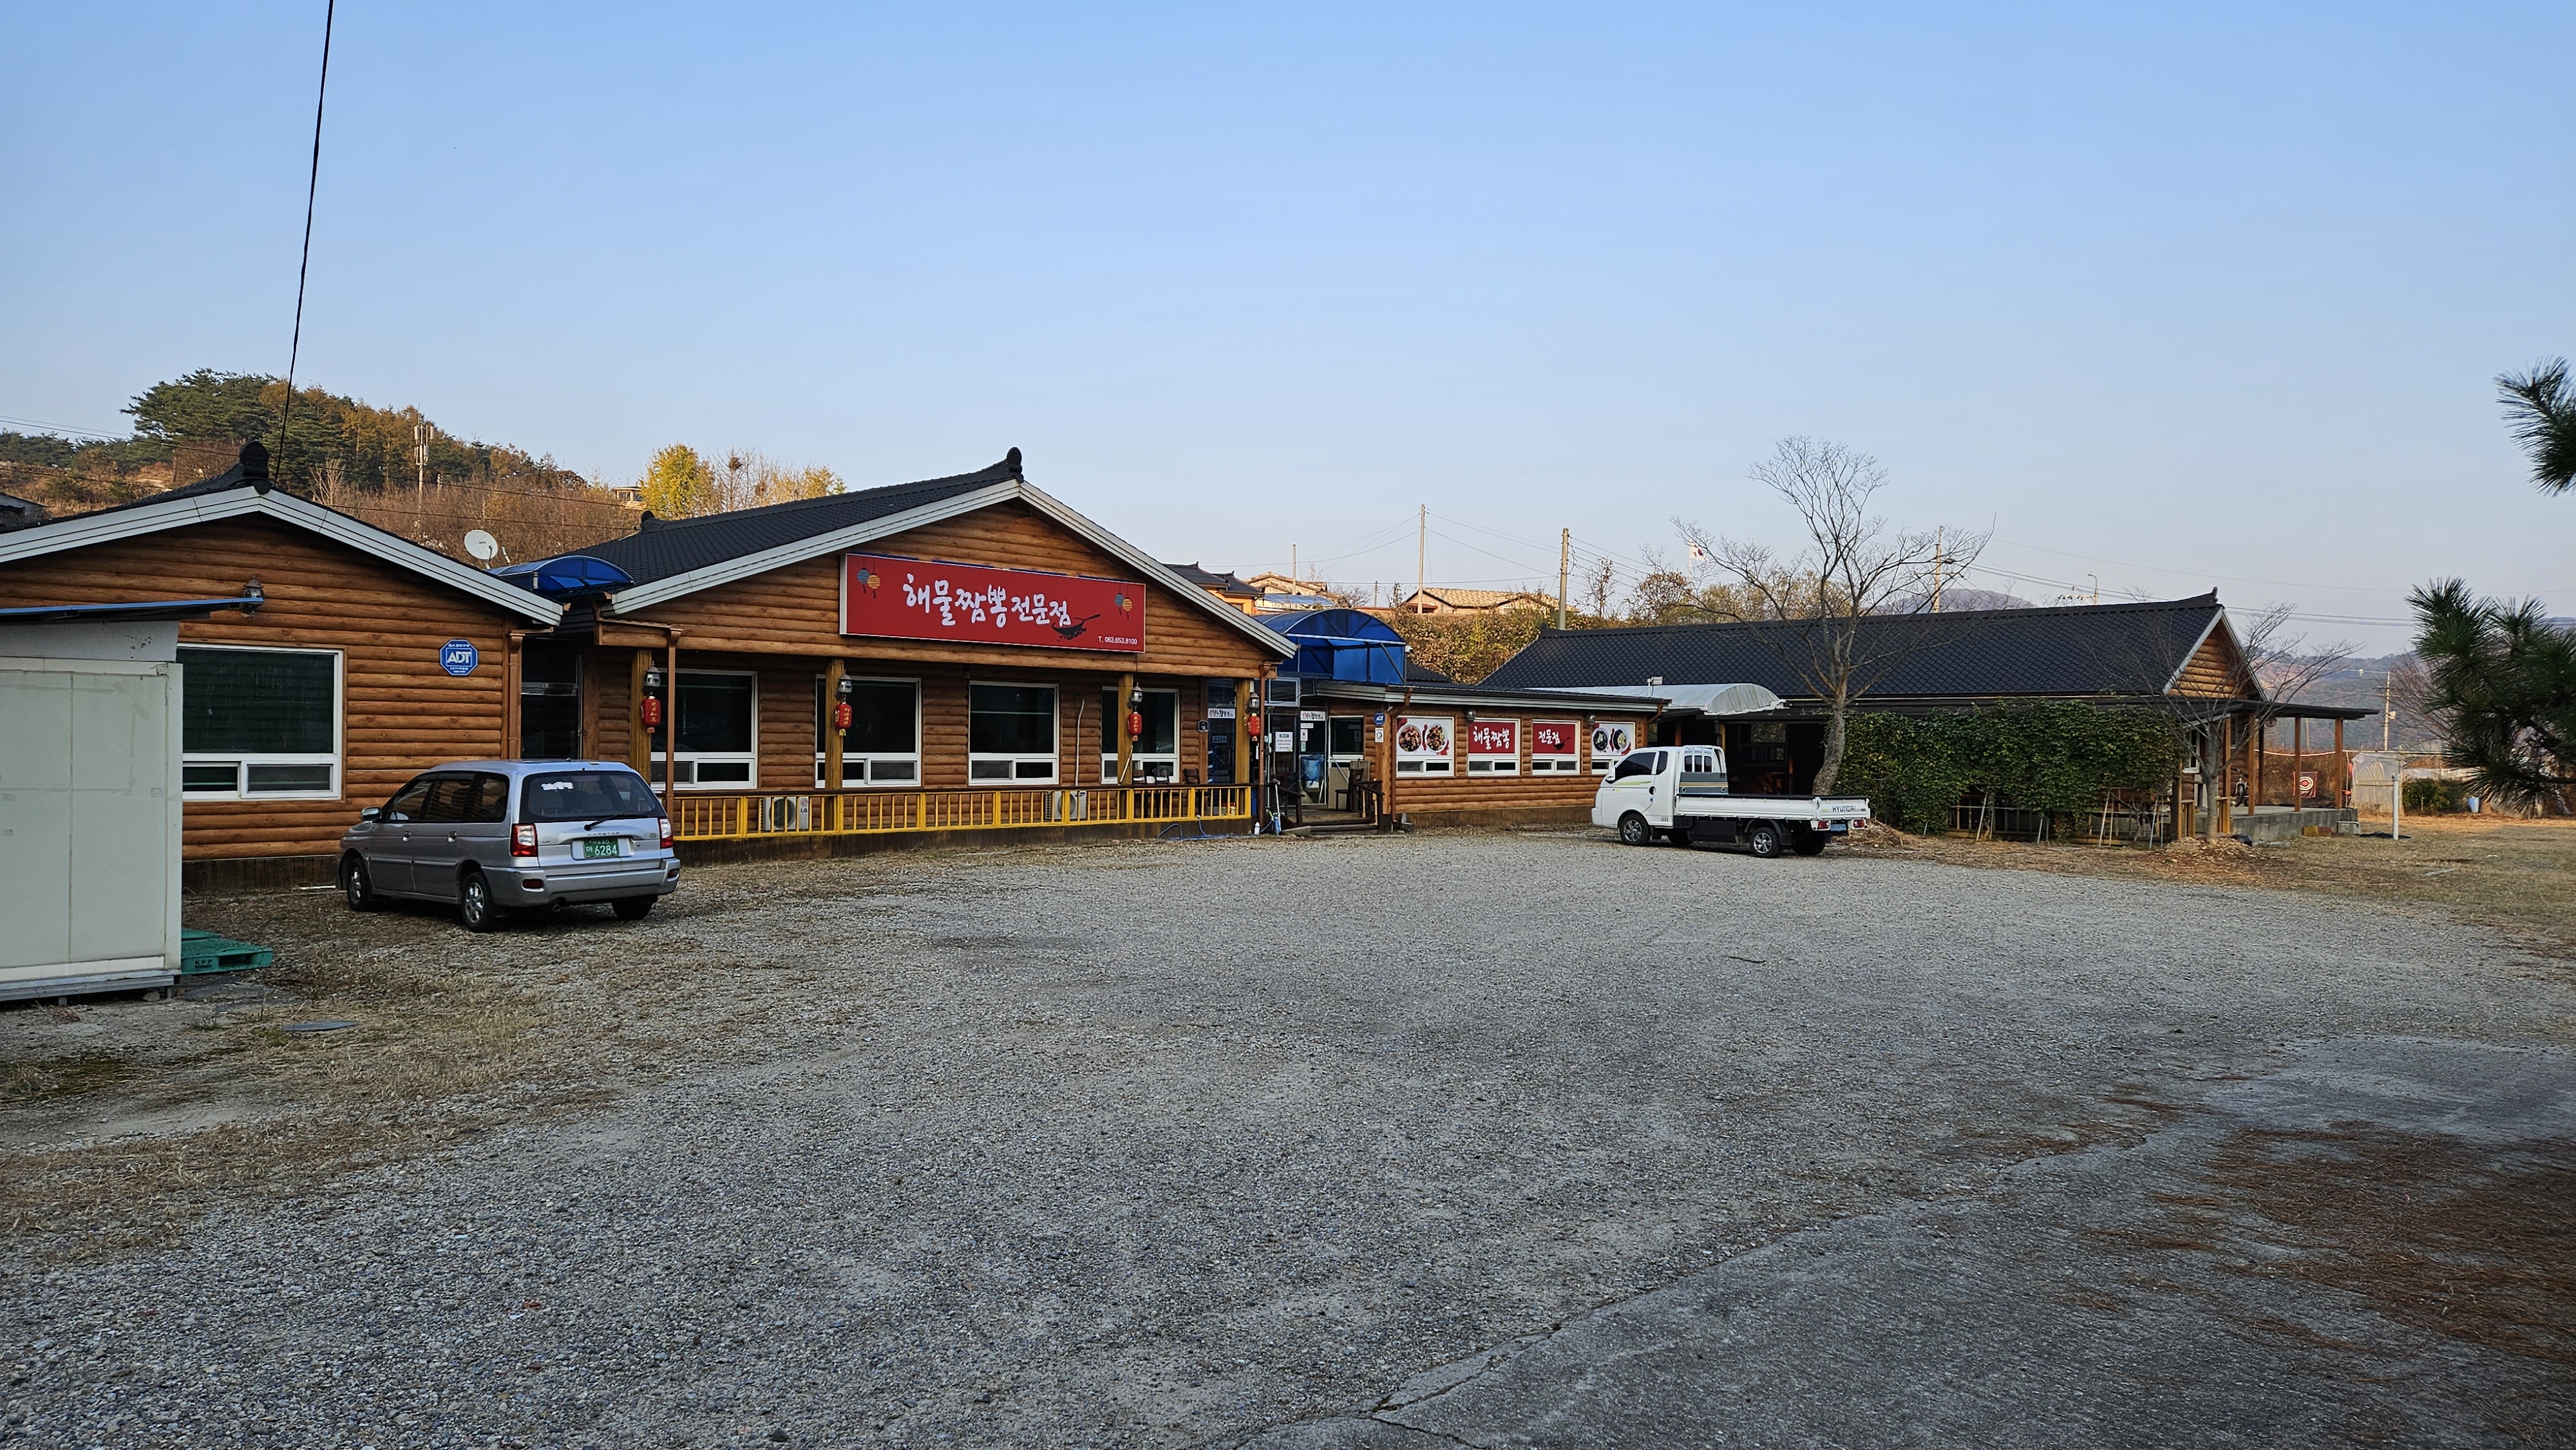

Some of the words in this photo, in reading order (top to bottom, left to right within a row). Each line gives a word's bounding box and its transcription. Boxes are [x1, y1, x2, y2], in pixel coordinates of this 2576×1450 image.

[903, 573, 1008, 628] 해물짬뽕
[1011, 593, 1072, 627] 전문점
[1104, 636, 1138, 645] 063.653.8100
[447, 651, 471, 664] ADT
[1473, 726, 1510, 750] 해물짬뽕
[1538, 729, 1560, 745] 전문점
[594, 844, 618, 856] 6284
